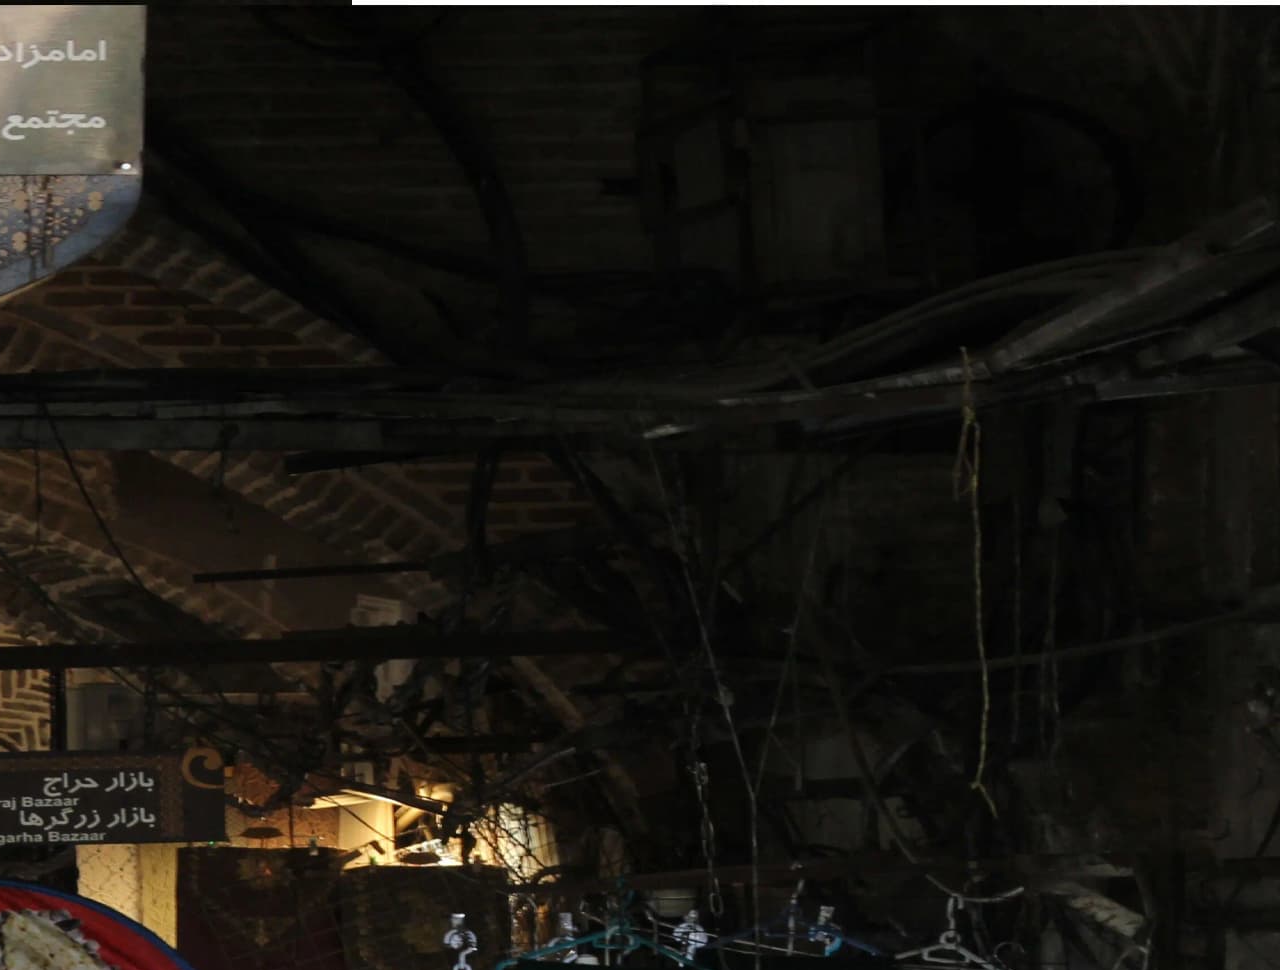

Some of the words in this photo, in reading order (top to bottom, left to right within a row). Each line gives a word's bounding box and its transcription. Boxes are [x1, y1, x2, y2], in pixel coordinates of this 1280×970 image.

[1, 110, 107, 141] مجتمع
[42, 772, 100, 798] حراج
[104, 771, 155, 793] بازار
[20, 796, 80, 808] Bazaar
[18, 807, 102, 831] زرگرها
[106, 807, 157, 829] بازار
[47, 831, 107, 843] Bazaar
